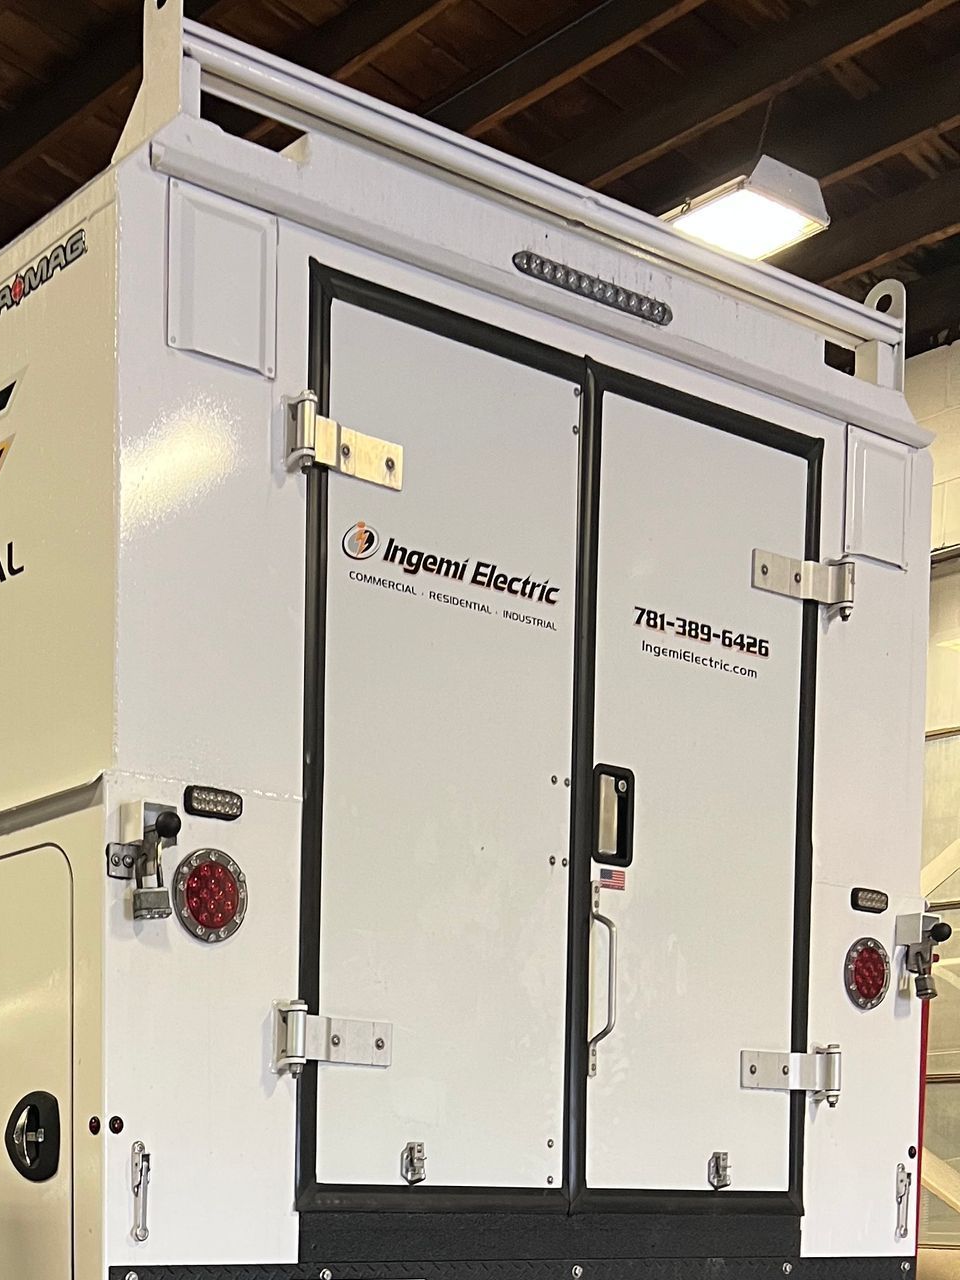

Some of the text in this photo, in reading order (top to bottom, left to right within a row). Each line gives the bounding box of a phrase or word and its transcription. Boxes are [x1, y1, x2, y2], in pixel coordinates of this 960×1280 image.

[382, 537, 560, 606] Ingemi Electric
[348, 570, 558, 632] COMMERCIAL RESIDENTIAL INDUSTRIAL
[634, 605, 770, 657] 781-389-6426
[641, 639, 758, 679] IngemiElectric.com
